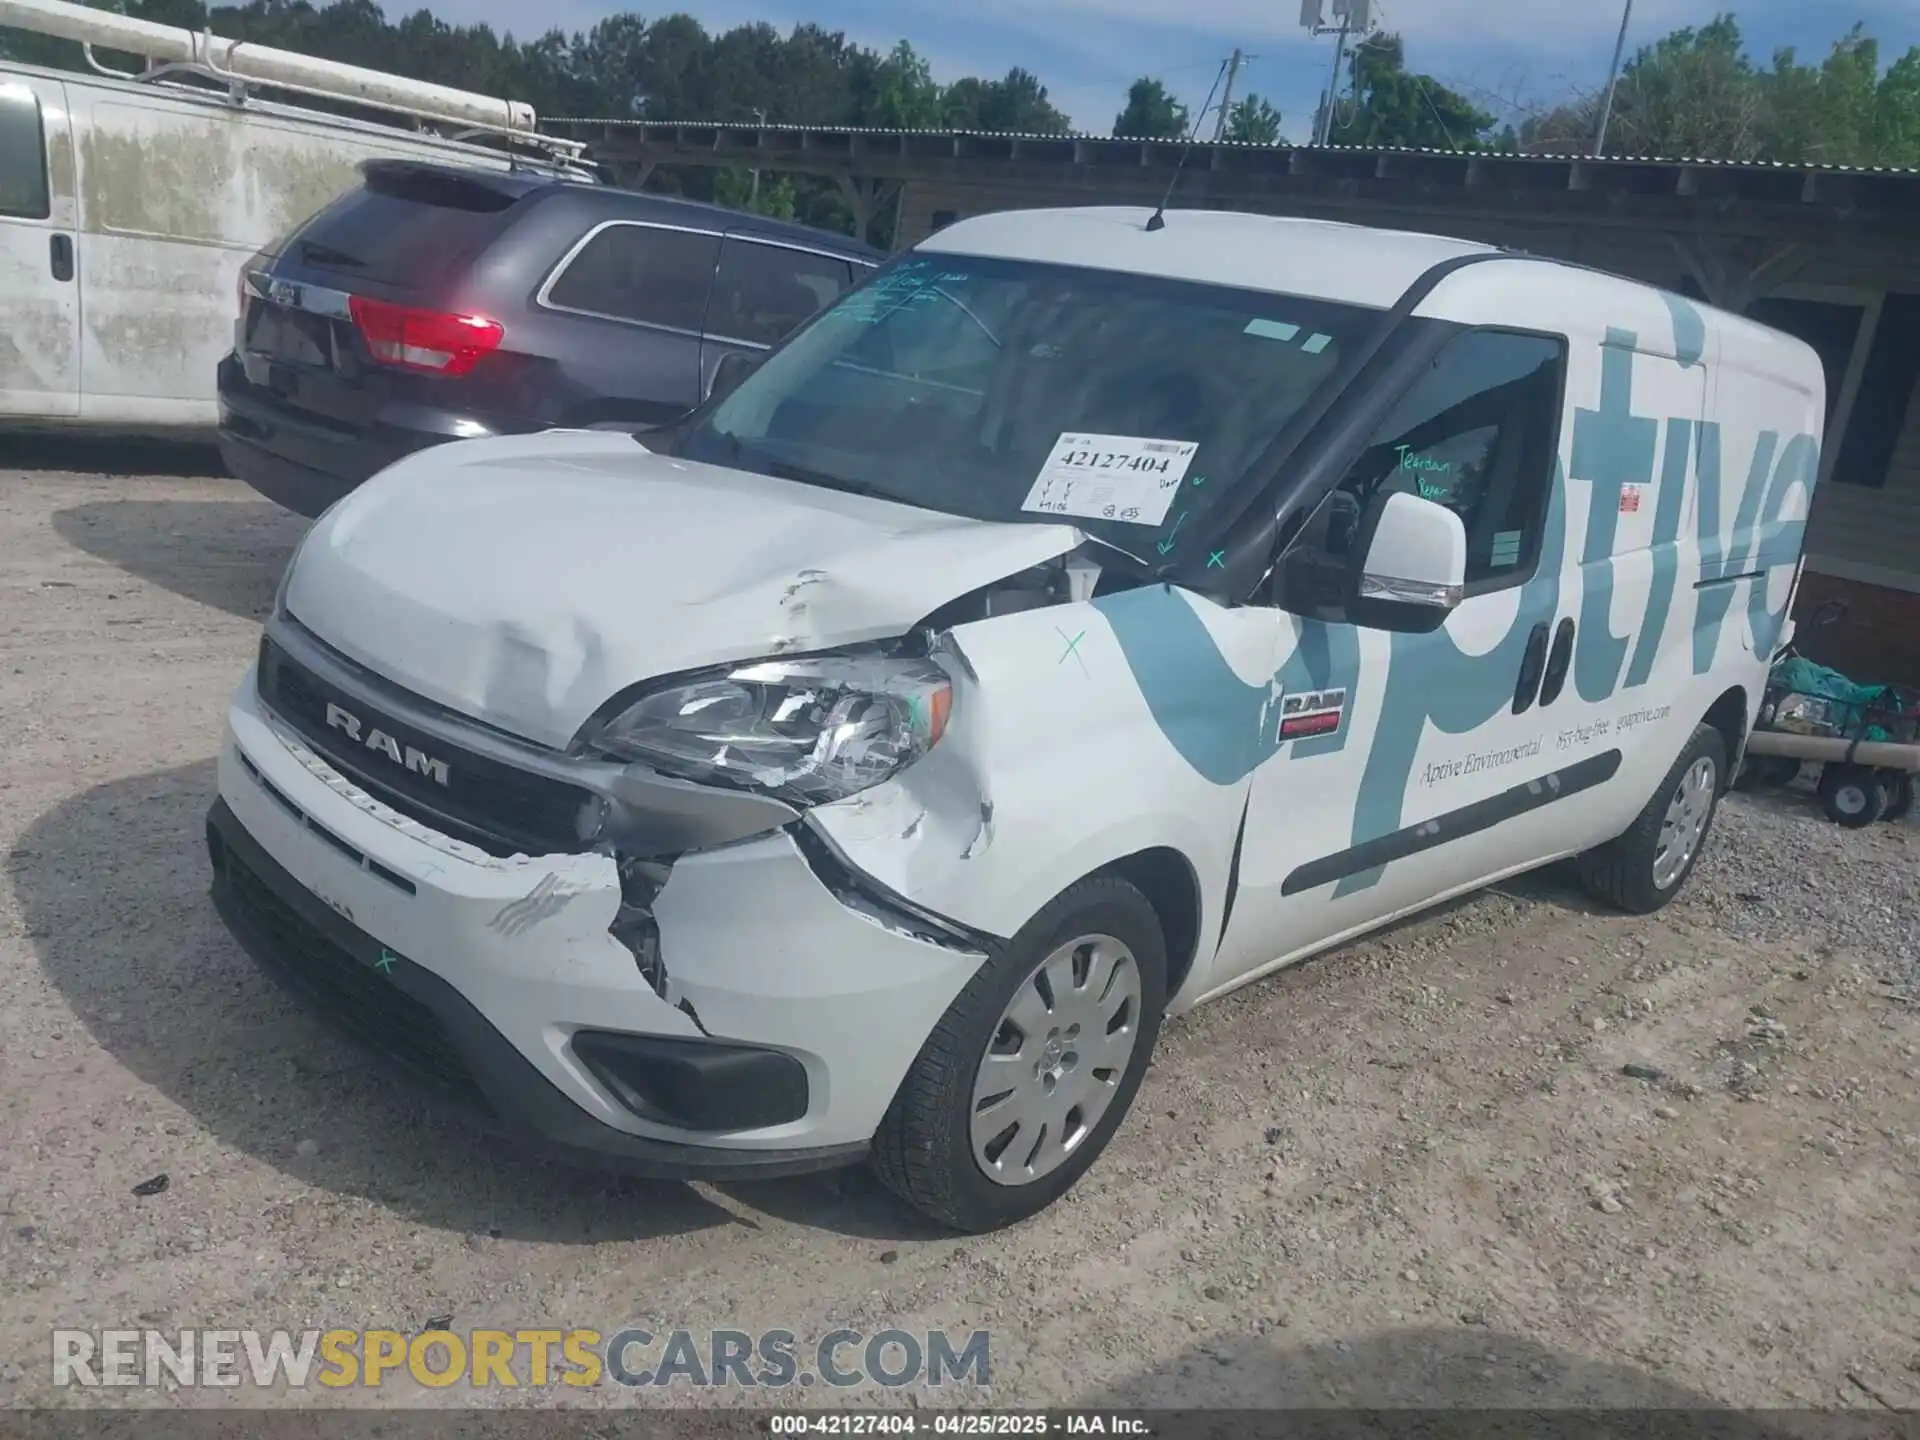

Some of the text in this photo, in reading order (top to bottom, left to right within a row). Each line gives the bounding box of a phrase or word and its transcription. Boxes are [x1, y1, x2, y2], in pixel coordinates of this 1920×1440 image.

[1061, 451, 1170, 473] 42127404
[1283, 691, 1344, 713] RAM
[326, 702, 450, 787] RAM
[1420, 758, 1462, 788] Aptive
[1463, 734, 1544, 776] Environmental
